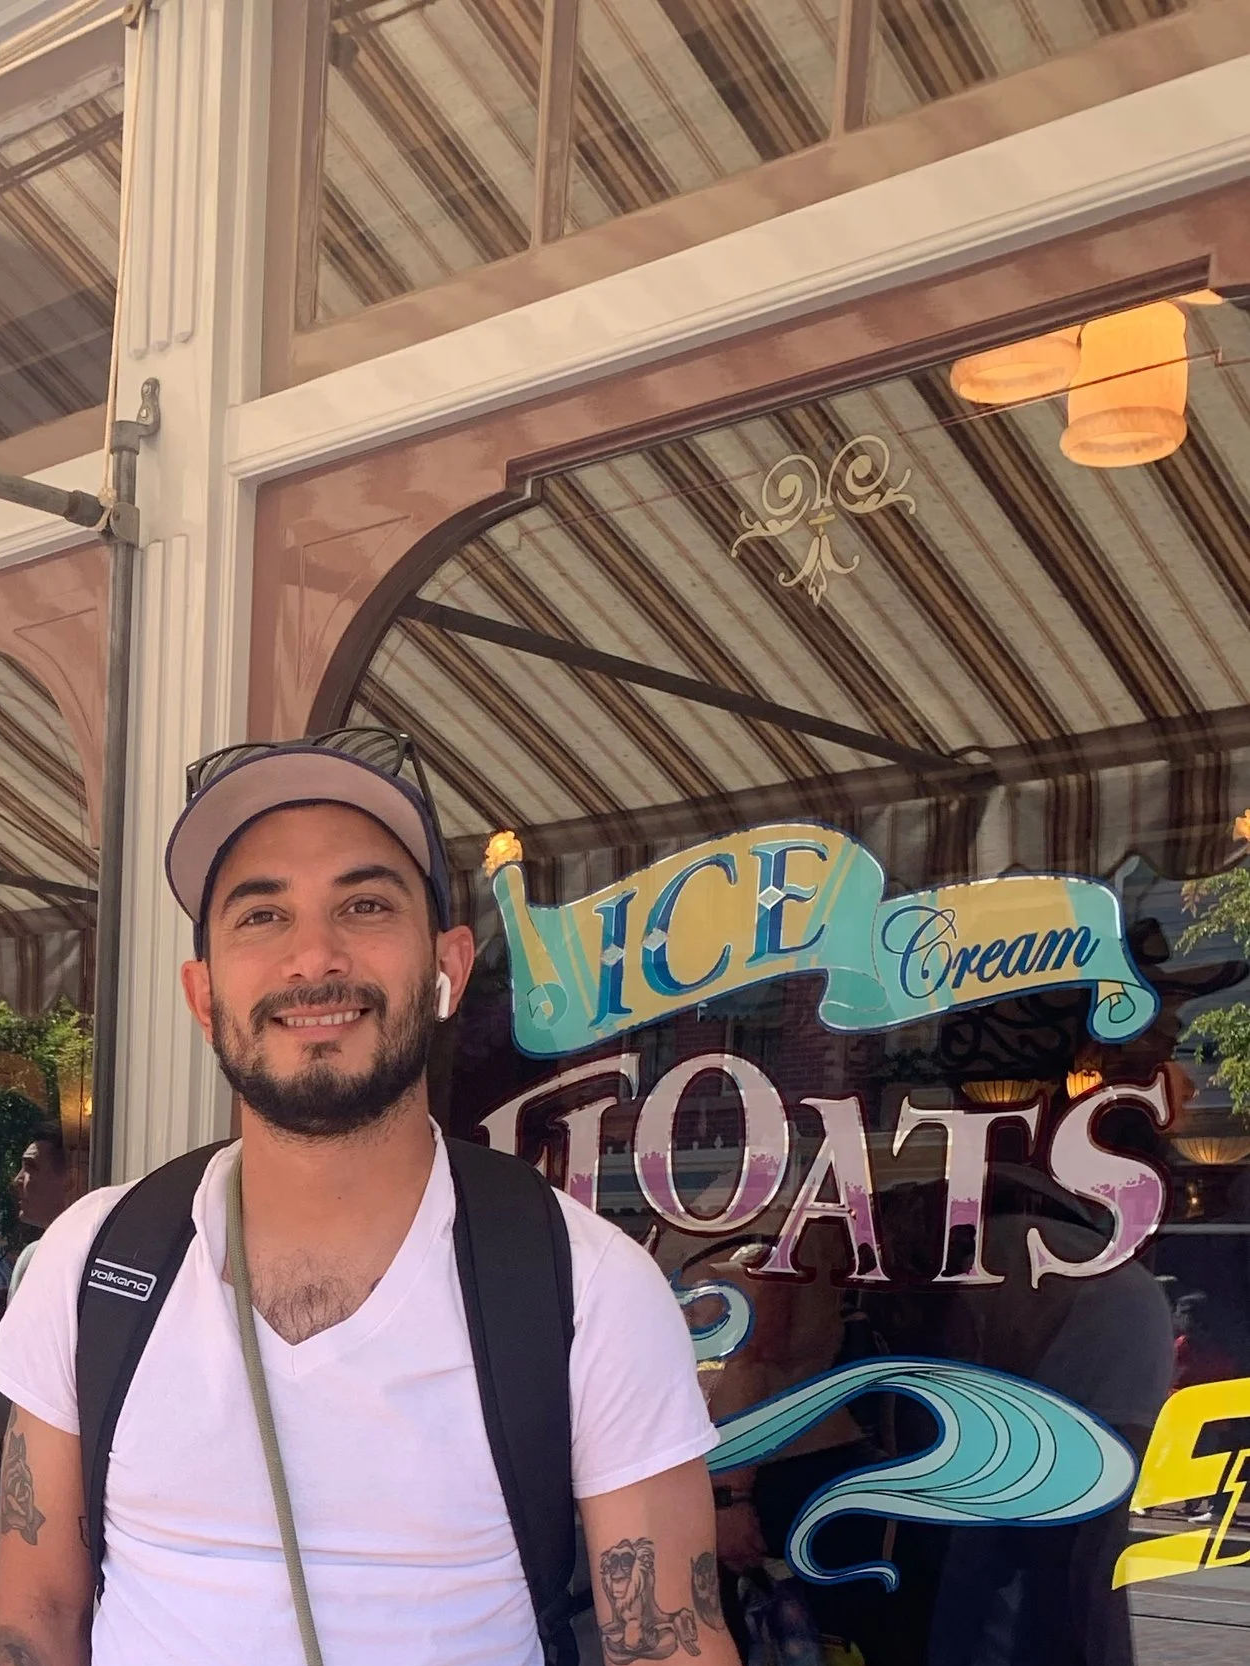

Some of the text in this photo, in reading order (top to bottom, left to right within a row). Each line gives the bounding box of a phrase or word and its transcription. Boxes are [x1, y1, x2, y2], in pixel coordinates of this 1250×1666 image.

[593, 839, 1102, 1026] ICE Cream
[90, 1268, 149, 1292] volkano
